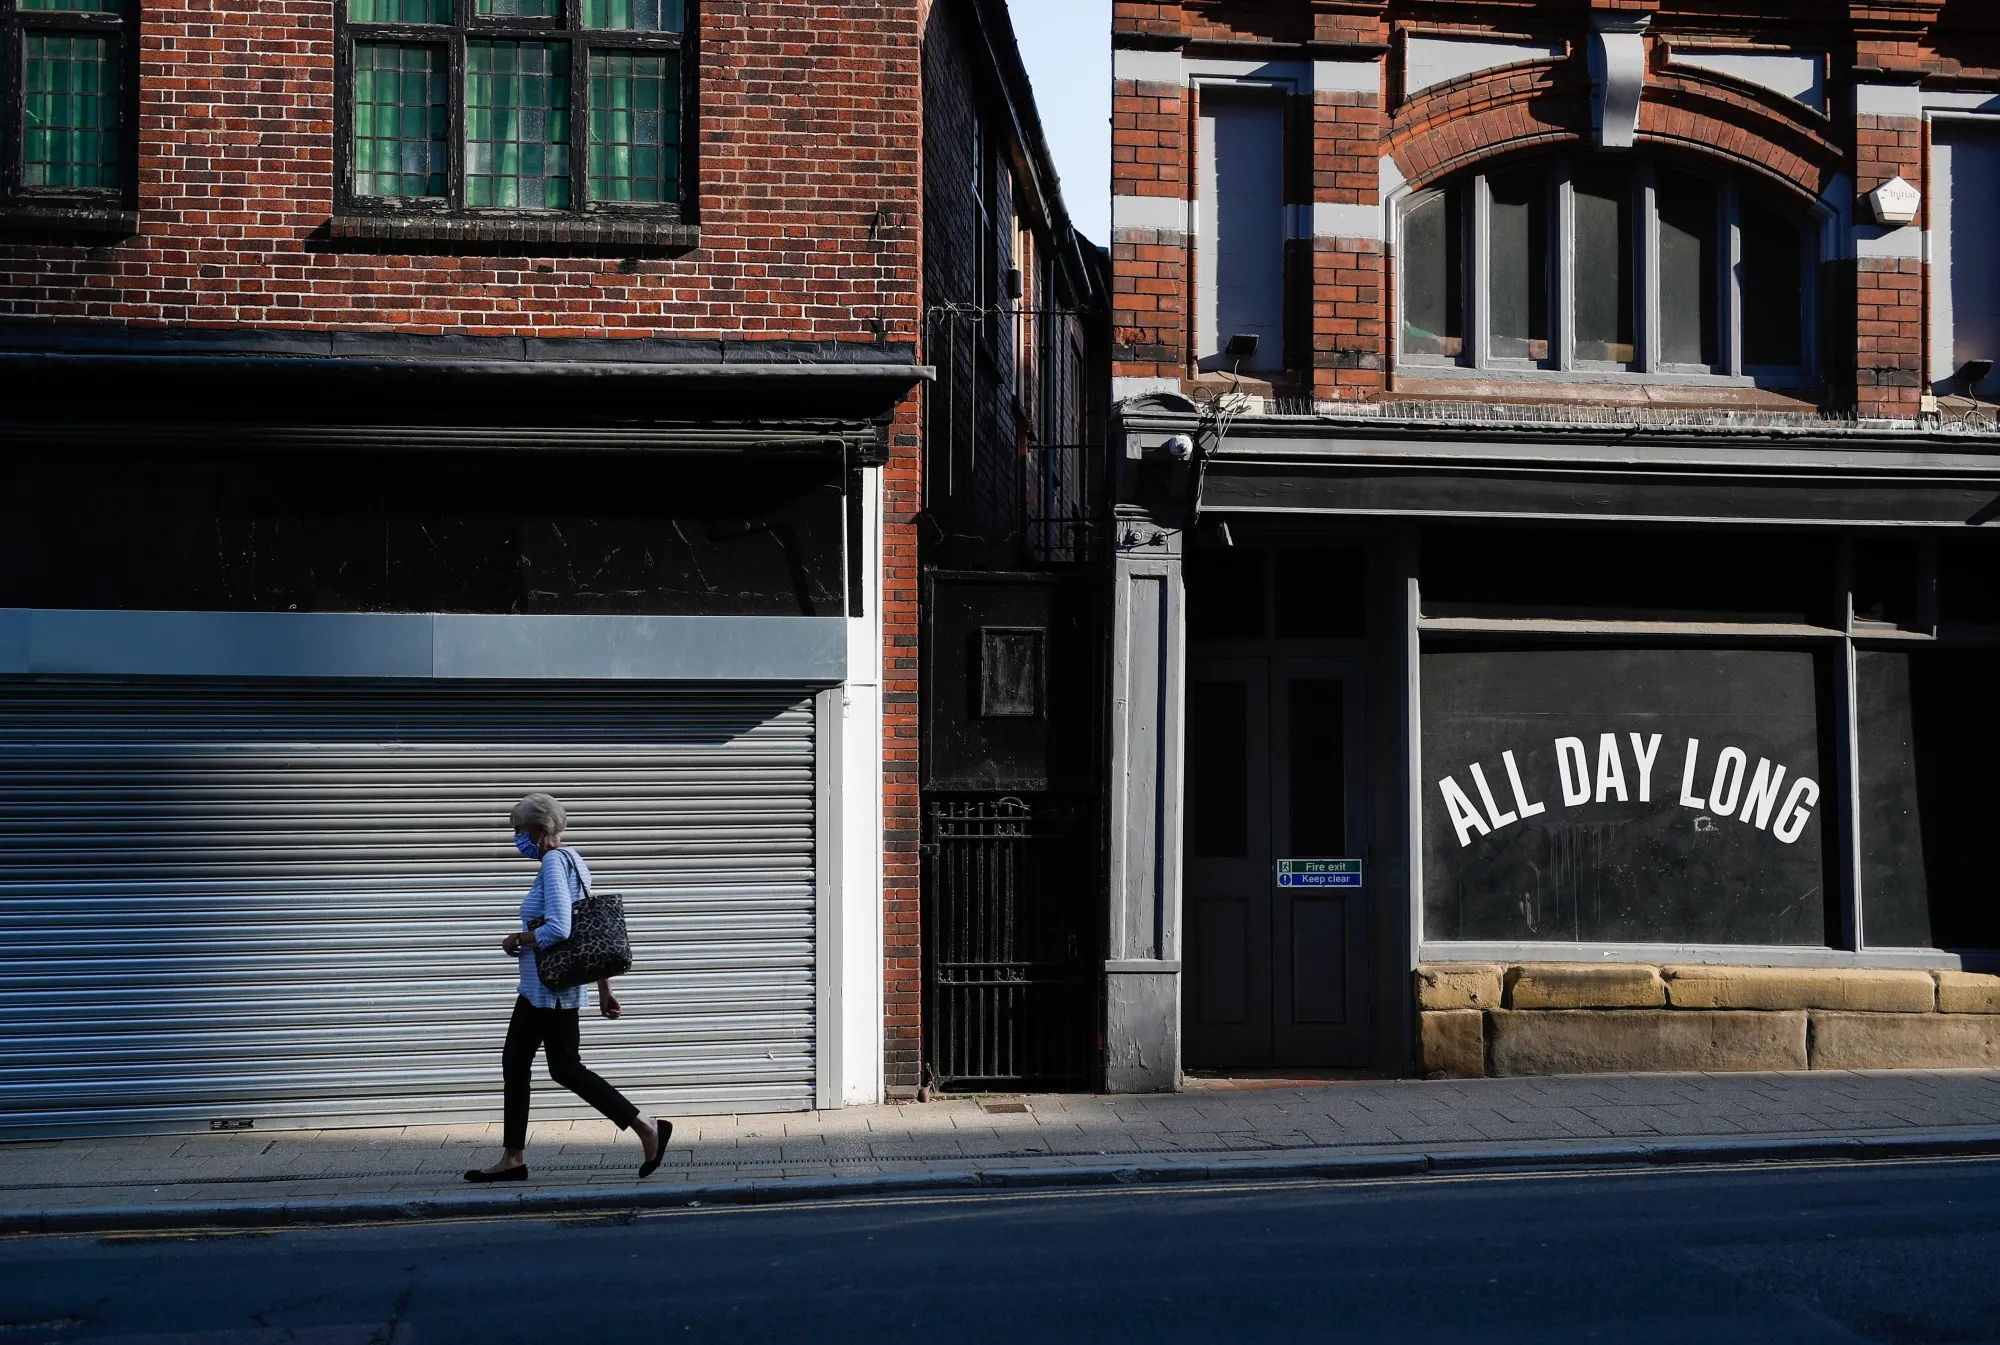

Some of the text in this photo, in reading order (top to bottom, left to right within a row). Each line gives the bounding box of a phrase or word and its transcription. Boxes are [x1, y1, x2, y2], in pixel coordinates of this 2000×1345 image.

[1890, 190, 1915, 198] Initial
[1438, 732, 1820, 848] ALL DAY LONG
[1305, 862, 1346, 871] Fire exit
[1302, 874, 1350, 884] Keep clear
